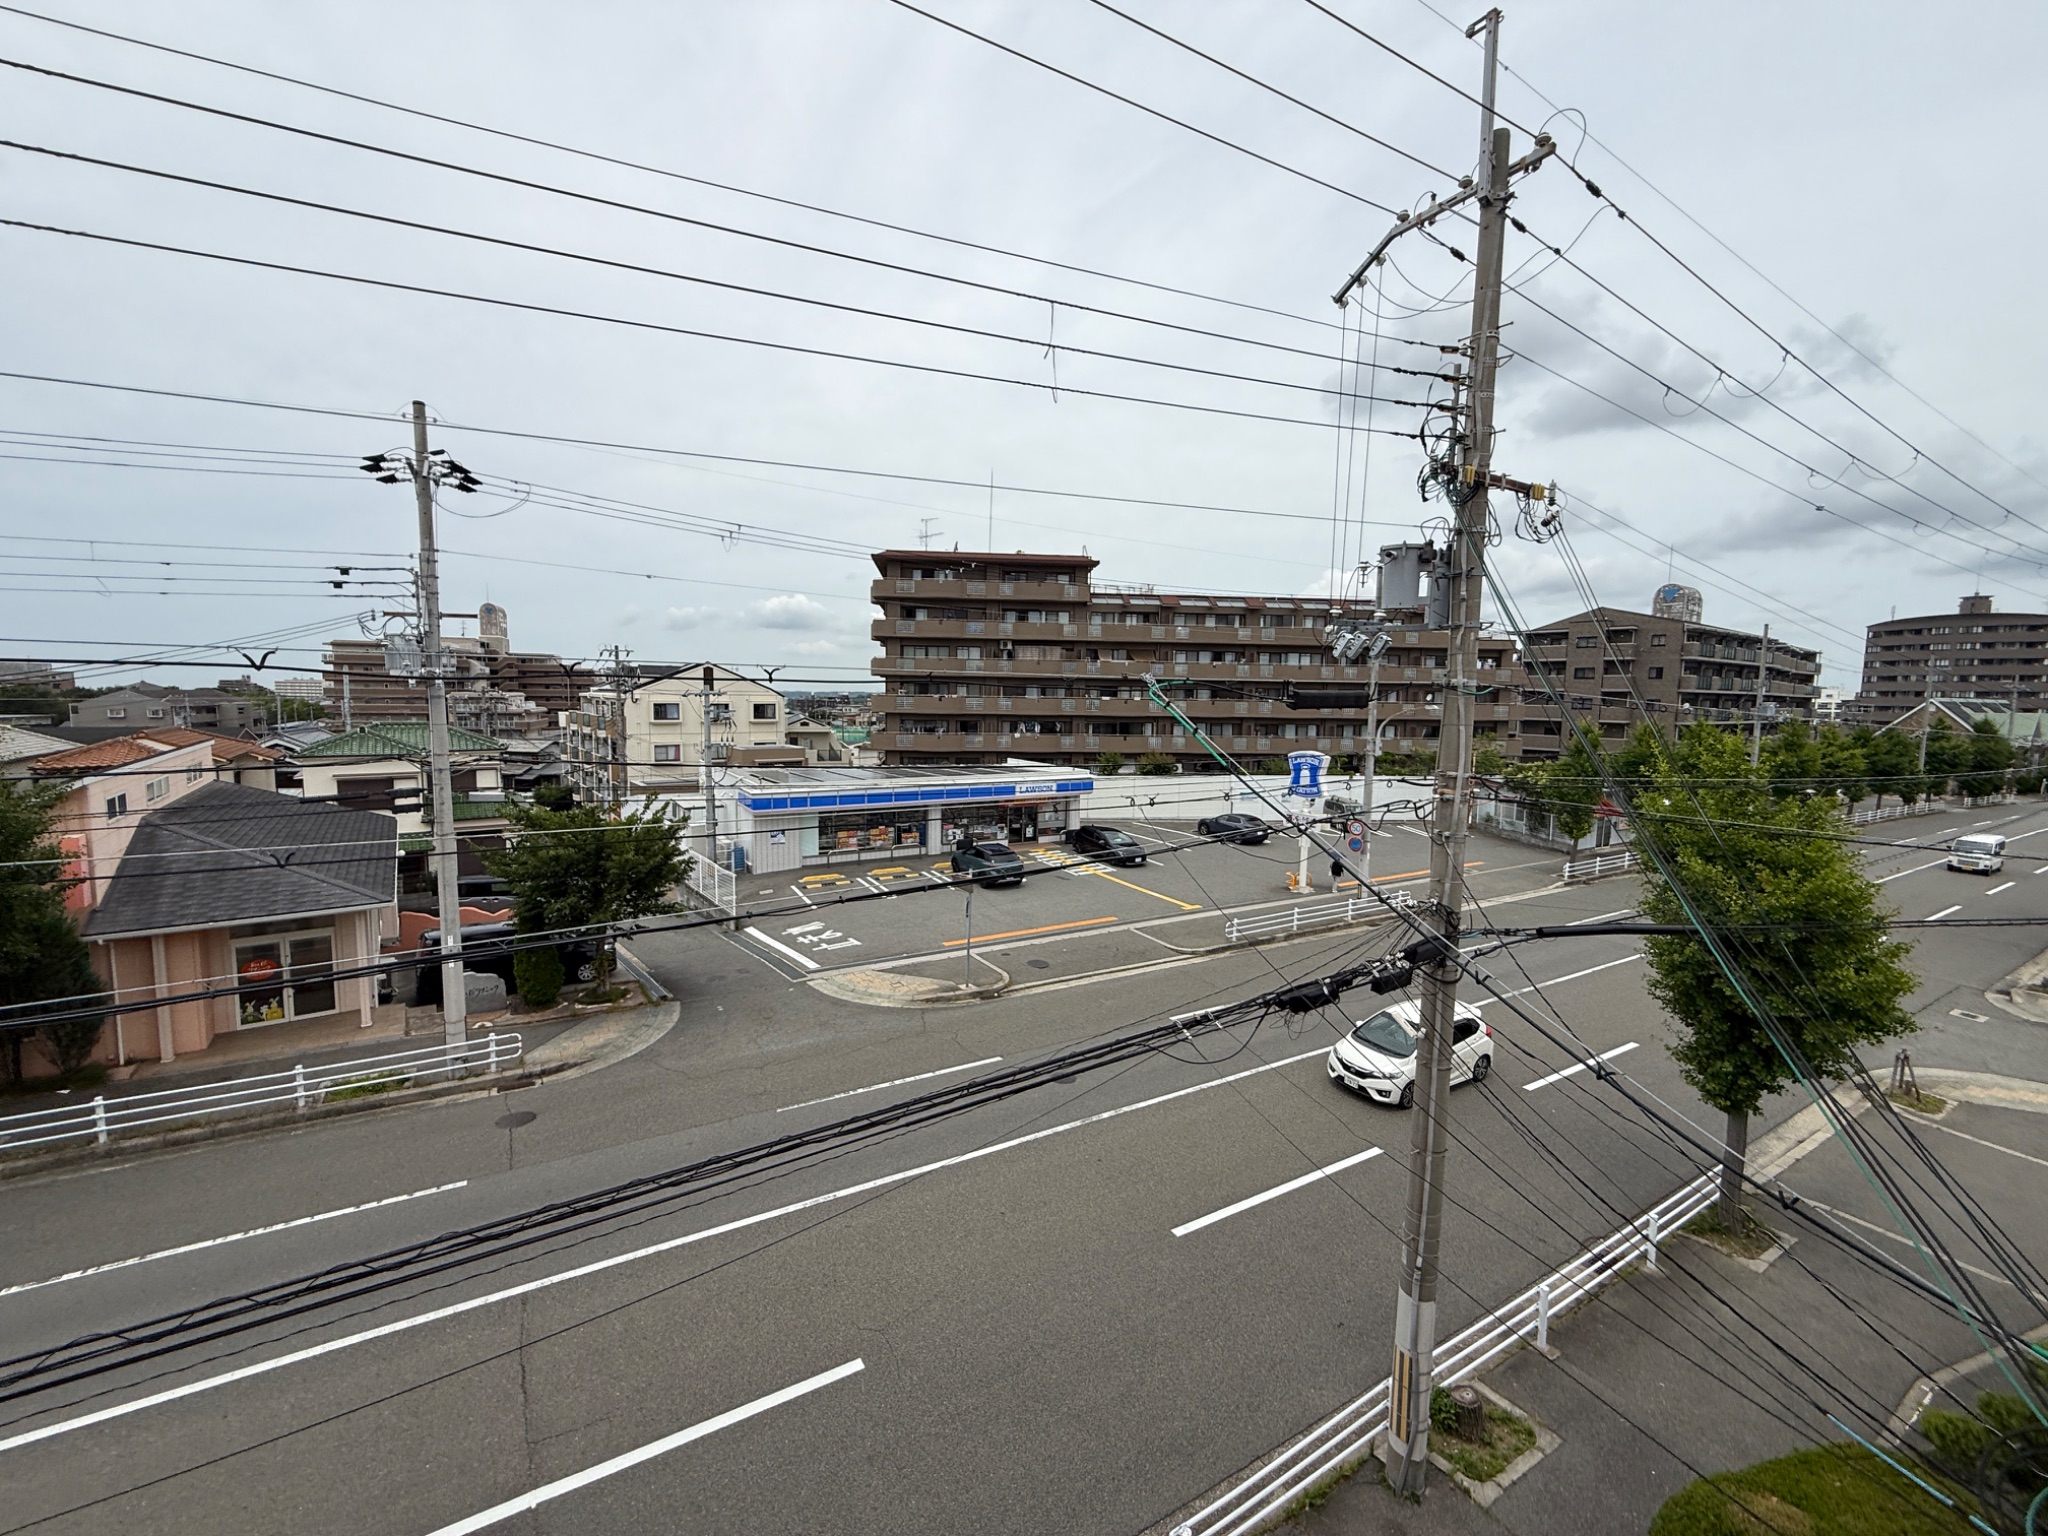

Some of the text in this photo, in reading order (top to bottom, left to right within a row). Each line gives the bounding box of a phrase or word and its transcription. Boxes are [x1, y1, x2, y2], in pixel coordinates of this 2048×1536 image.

[1291, 757, 1321, 766] LAWSON
[1018, 784, 1054, 794] LAWSON
[1351, 824, 1361, 832] 50
